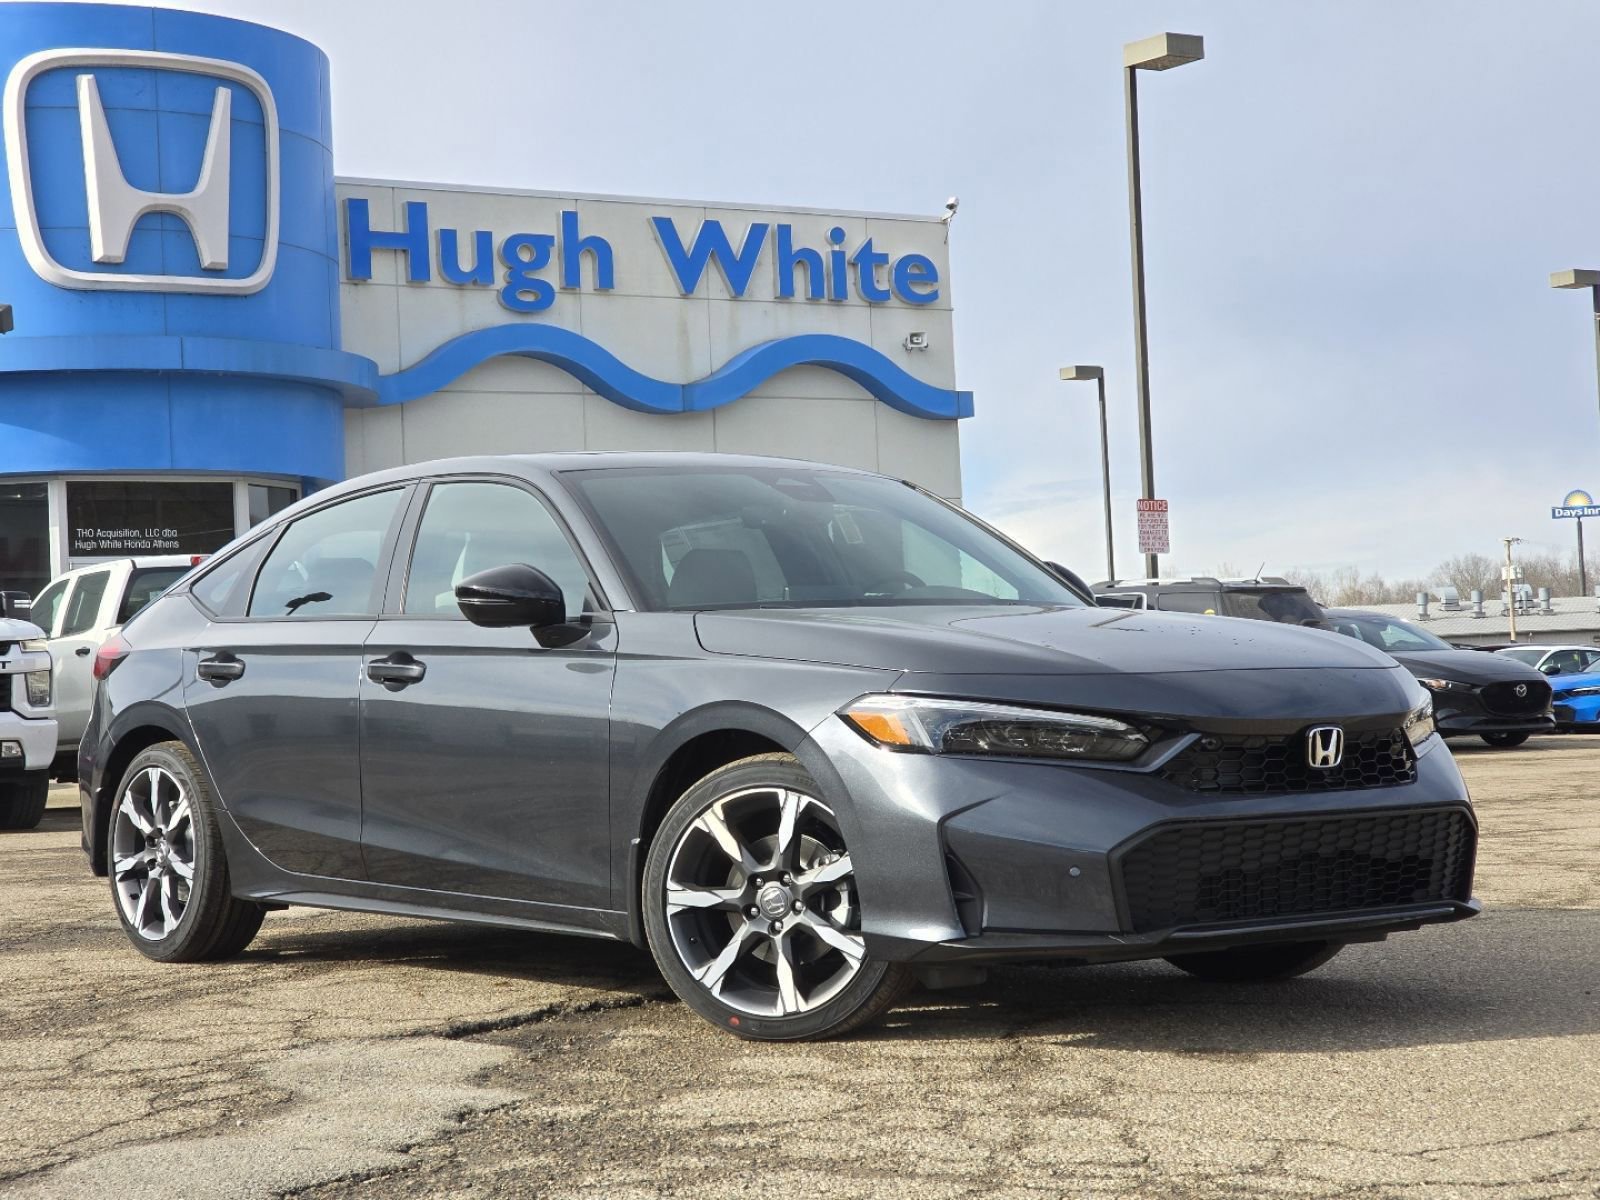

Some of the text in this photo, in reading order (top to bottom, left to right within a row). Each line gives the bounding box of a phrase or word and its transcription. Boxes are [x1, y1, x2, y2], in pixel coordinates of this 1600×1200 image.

[343, 197, 940, 313] Hugh White
[1137, 501, 1168, 511] NOTICE
[1555, 508, 1583, 517] Days
[96, 528, 142, 539] Acquisition,
[145, 528, 160, 538] LLC
[162, 528, 178, 538] dba
[75, 540, 180, 550] Hugh White Honda Athens
